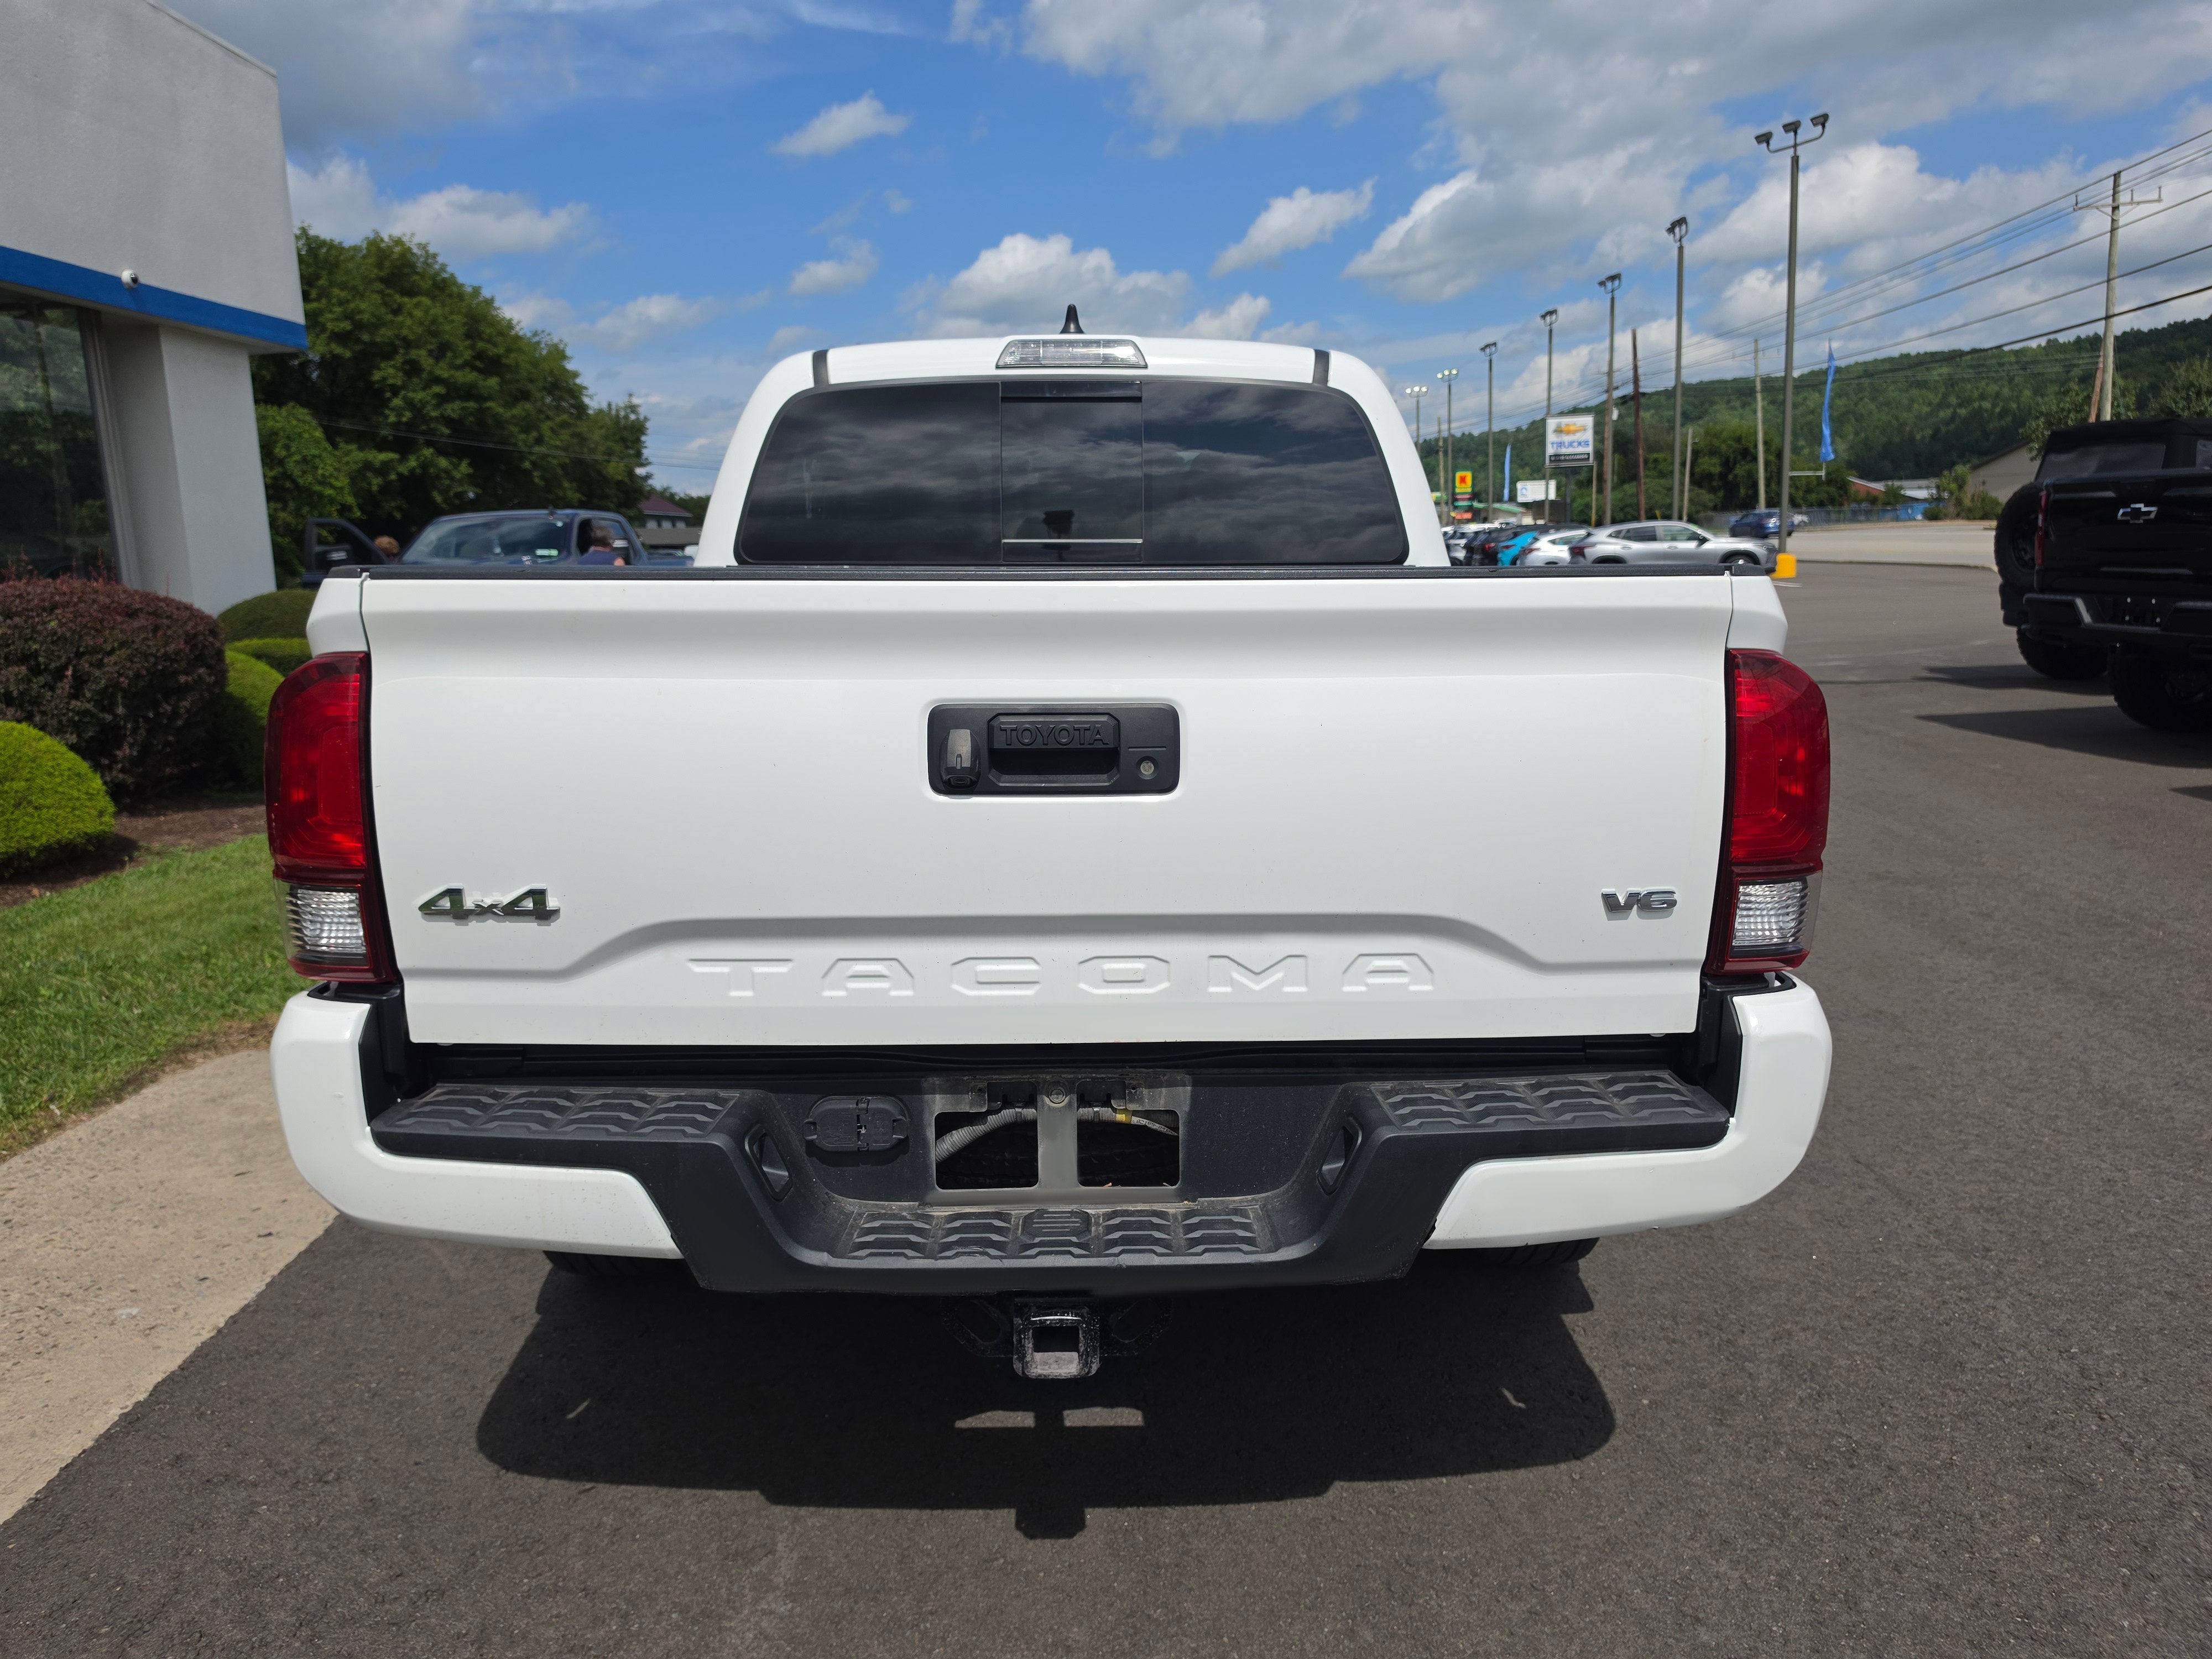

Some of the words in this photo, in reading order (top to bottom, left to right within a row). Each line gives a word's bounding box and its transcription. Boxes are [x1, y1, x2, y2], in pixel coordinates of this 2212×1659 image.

[1551, 440, 1590, 448] TRUCKS
[1000, 724, 1109, 746] TOYOTA
[418, 885, 561, 920] 4x4
[1601, 889, 1677, 912] V6
[687, 953, 1434, 997] TACOMA
